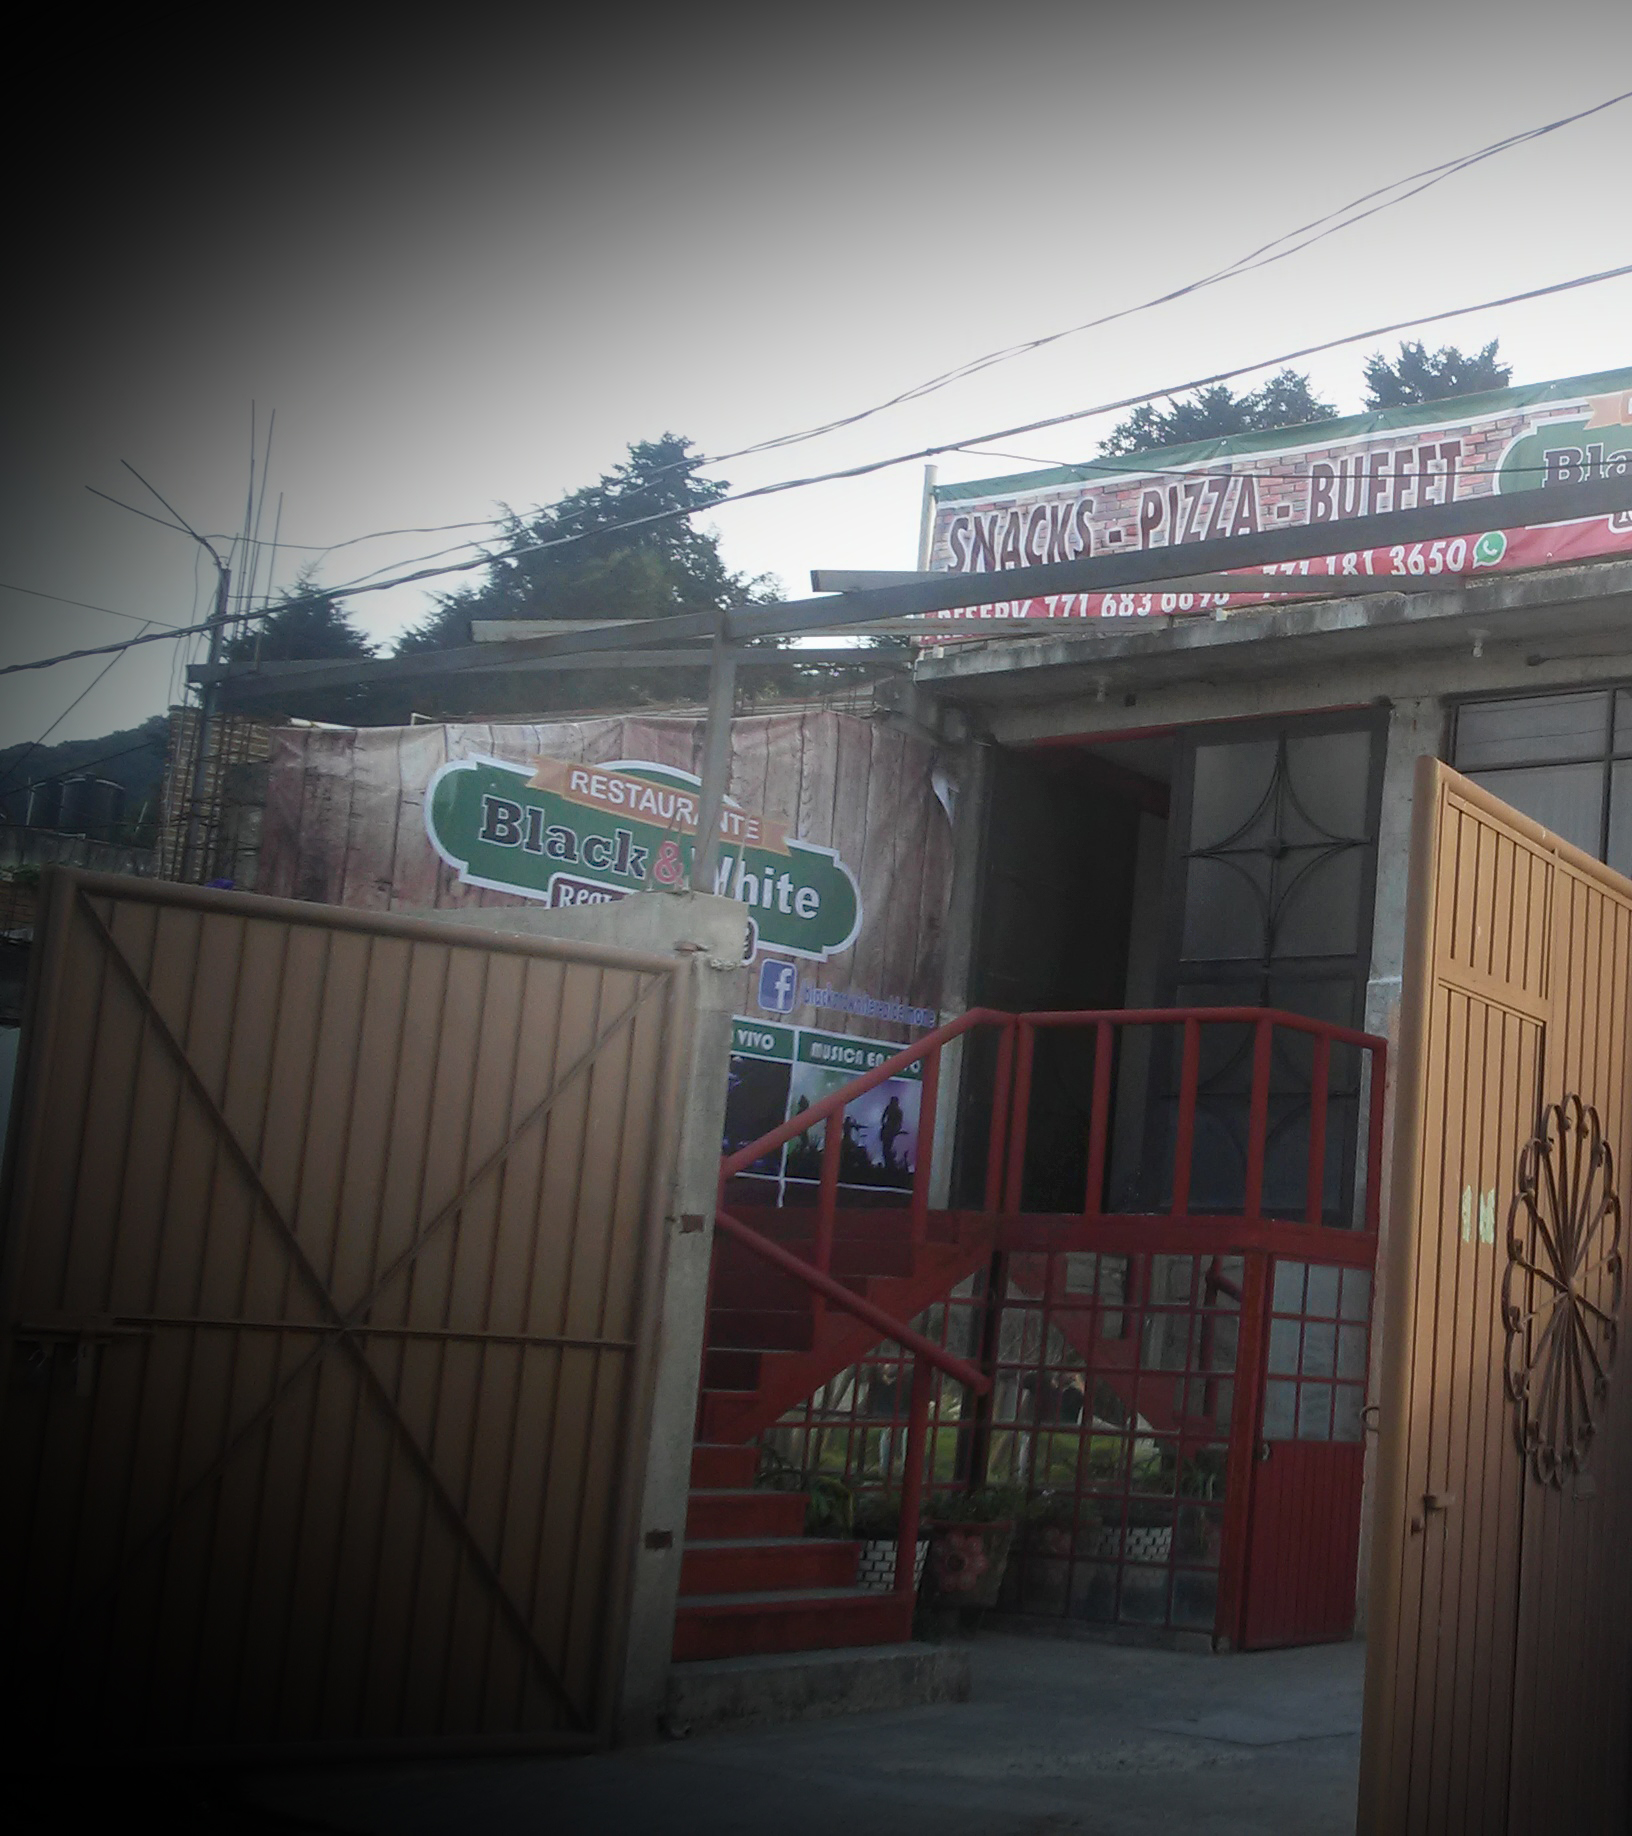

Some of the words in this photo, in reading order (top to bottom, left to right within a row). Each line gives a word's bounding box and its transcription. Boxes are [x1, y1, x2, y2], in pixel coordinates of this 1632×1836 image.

[947, 498, 1096, 573] SNACKS
[1140, 475, 1261, 551] PIZZA
[1310, 439, 1462, 523] BUFFET
[1390, 539, 1466, 576] 3650
[570, 770, 760, 839] RESTAURNTE
[479, 795, 650, 878] Black
[653, 840, 684, 887] &
[738, 1029, 776, 1051] VIVO
[811, 1041, 863, 1066] MUSICA
